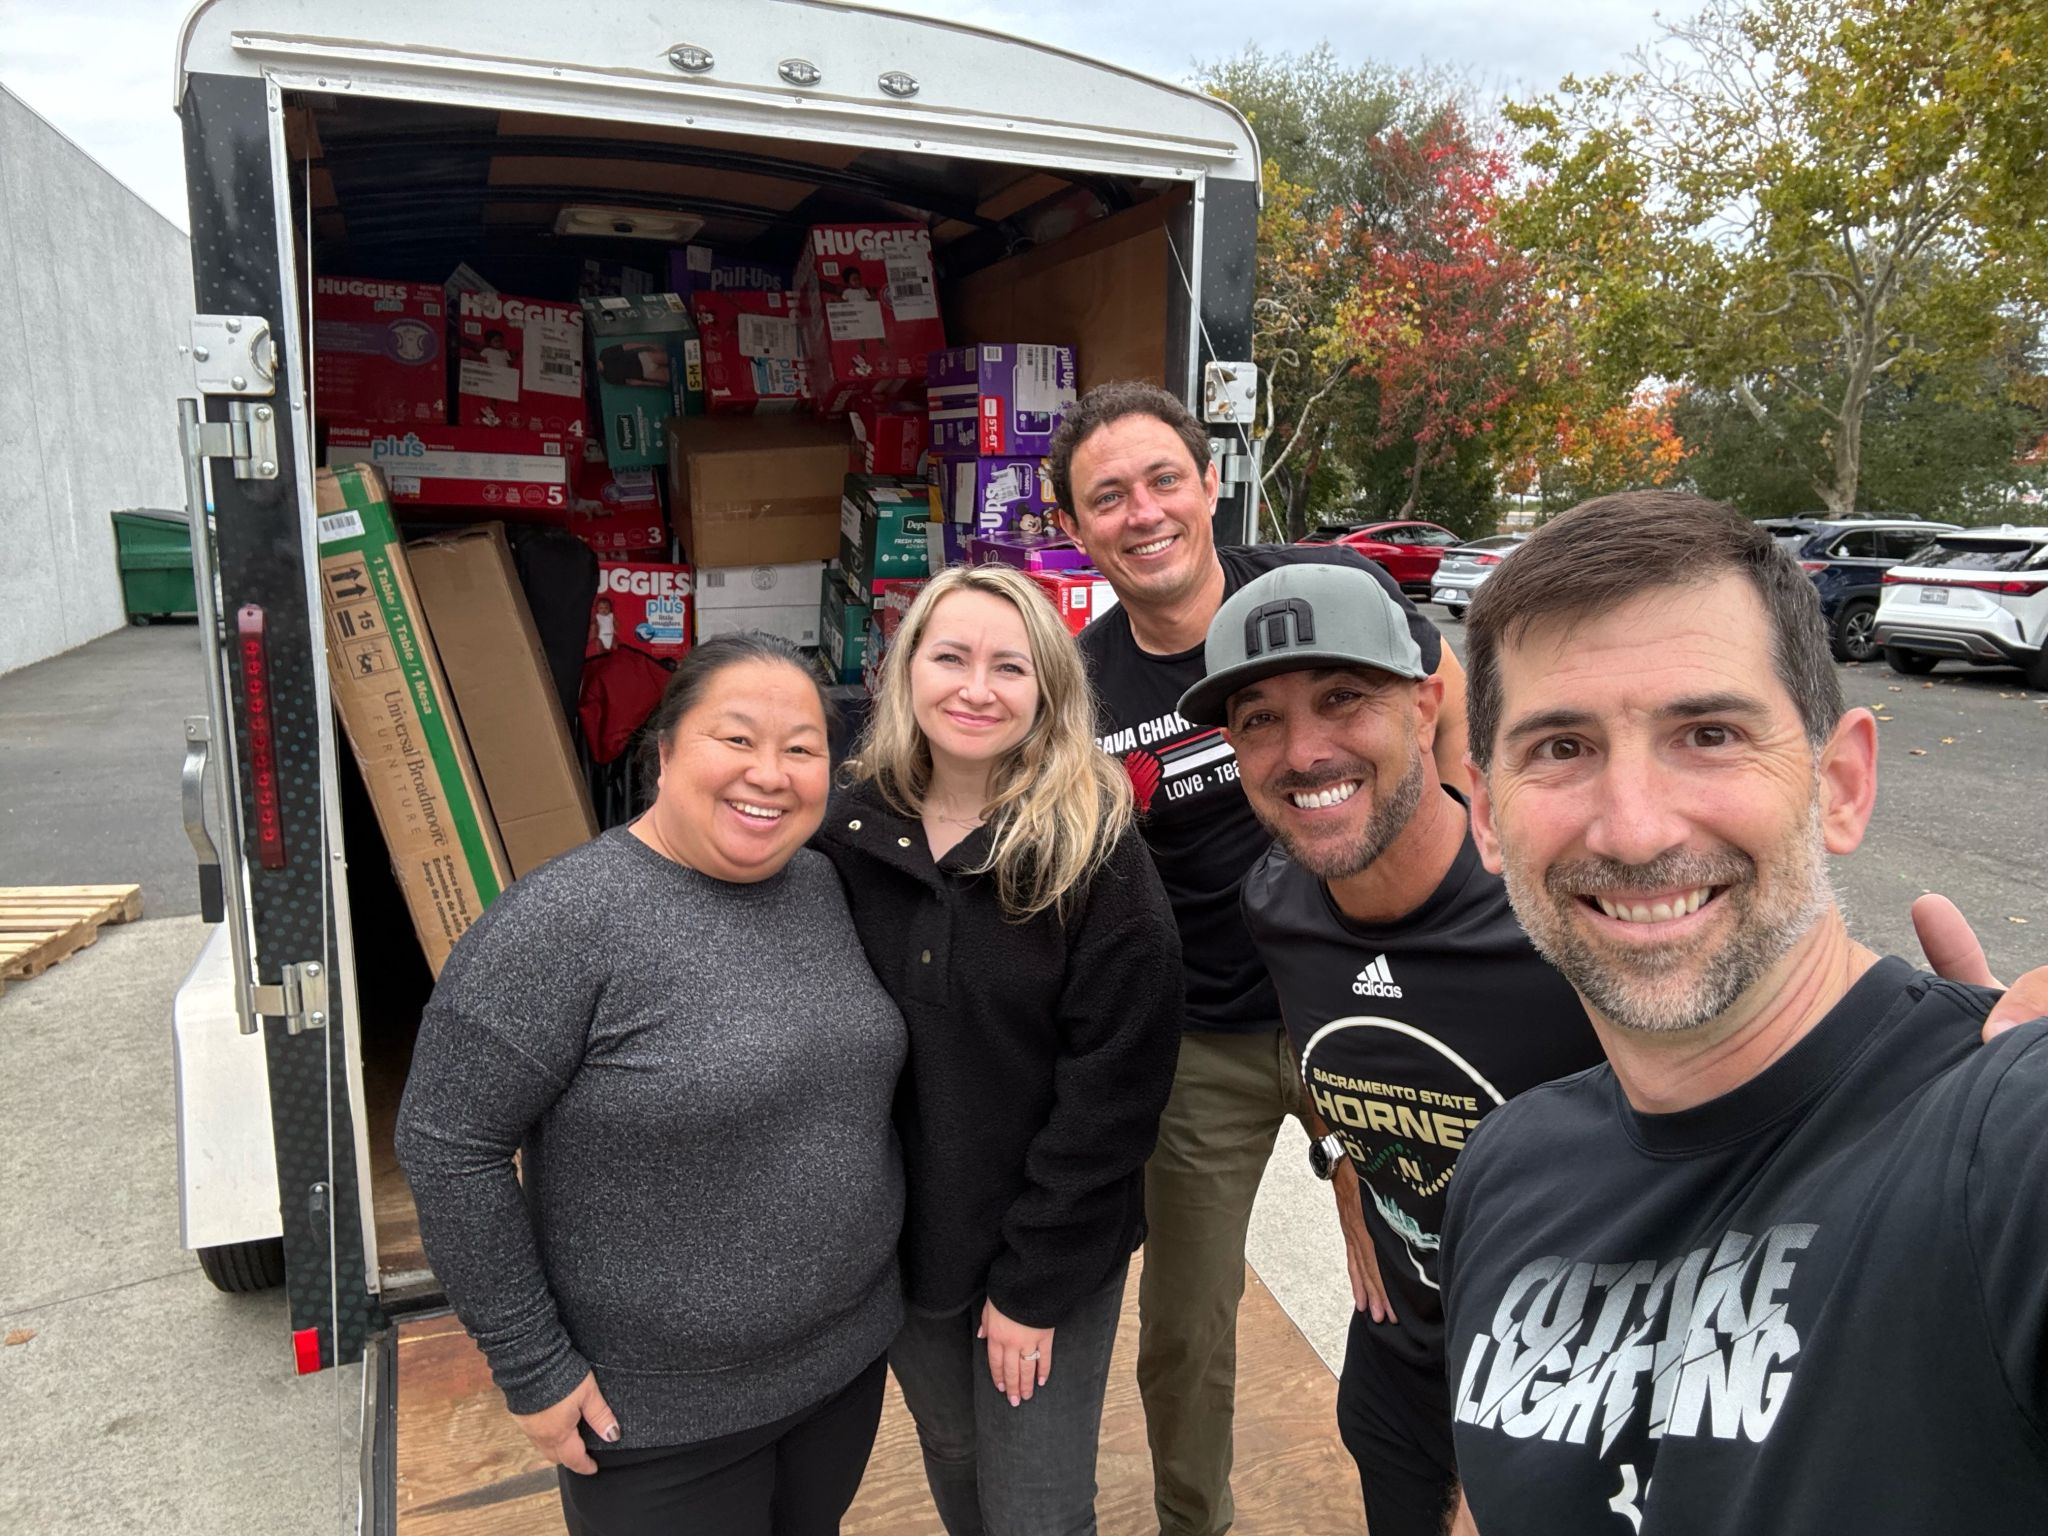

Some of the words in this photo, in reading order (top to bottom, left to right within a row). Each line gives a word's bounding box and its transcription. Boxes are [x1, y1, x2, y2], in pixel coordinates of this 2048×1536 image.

[317, 277, 408, 300] HUGGIES
[711, 265, 783, 291] Pull-Ups
[460, 292, 583, 328] HUGGIES
[688, 364, 701, 388] S-M
[432, 399, 444, 412] 4
[329, 426, 370, 438] HUGGIES
[567, 418, 584, 438] 4
[988, 418, 998, 448] 5T-6T
[373, 434, 426, 460] plus
[546, 485, 563, 505] 5
[647, 526, 662, 544] 3
[373, 556, 384, 565] 1
[377, 566, 396, 606] Table
[392, 613, 403, 622] 1
[648, 595, 684, 616] plus
[358, 610, 375, 630] 15
[395, 625, 414, 662] Table
[411, 669, 422, 678] 1
[414, 680, 432, 715] Mesa
[372, 714, 421, 836] FURNITURE
[384, 689, 421, 757] Universal
[407, 757, 448, 847] Broadmoore
[432, 857, 450, 899] Ensemble
[454, 888, 467, 915] Dining
[1352, 980, 1403, 999] adidas
[1313, 1067, 1417, 1101] SACRAMENTO
[1419, 1090, 1478, 1112] STATE
